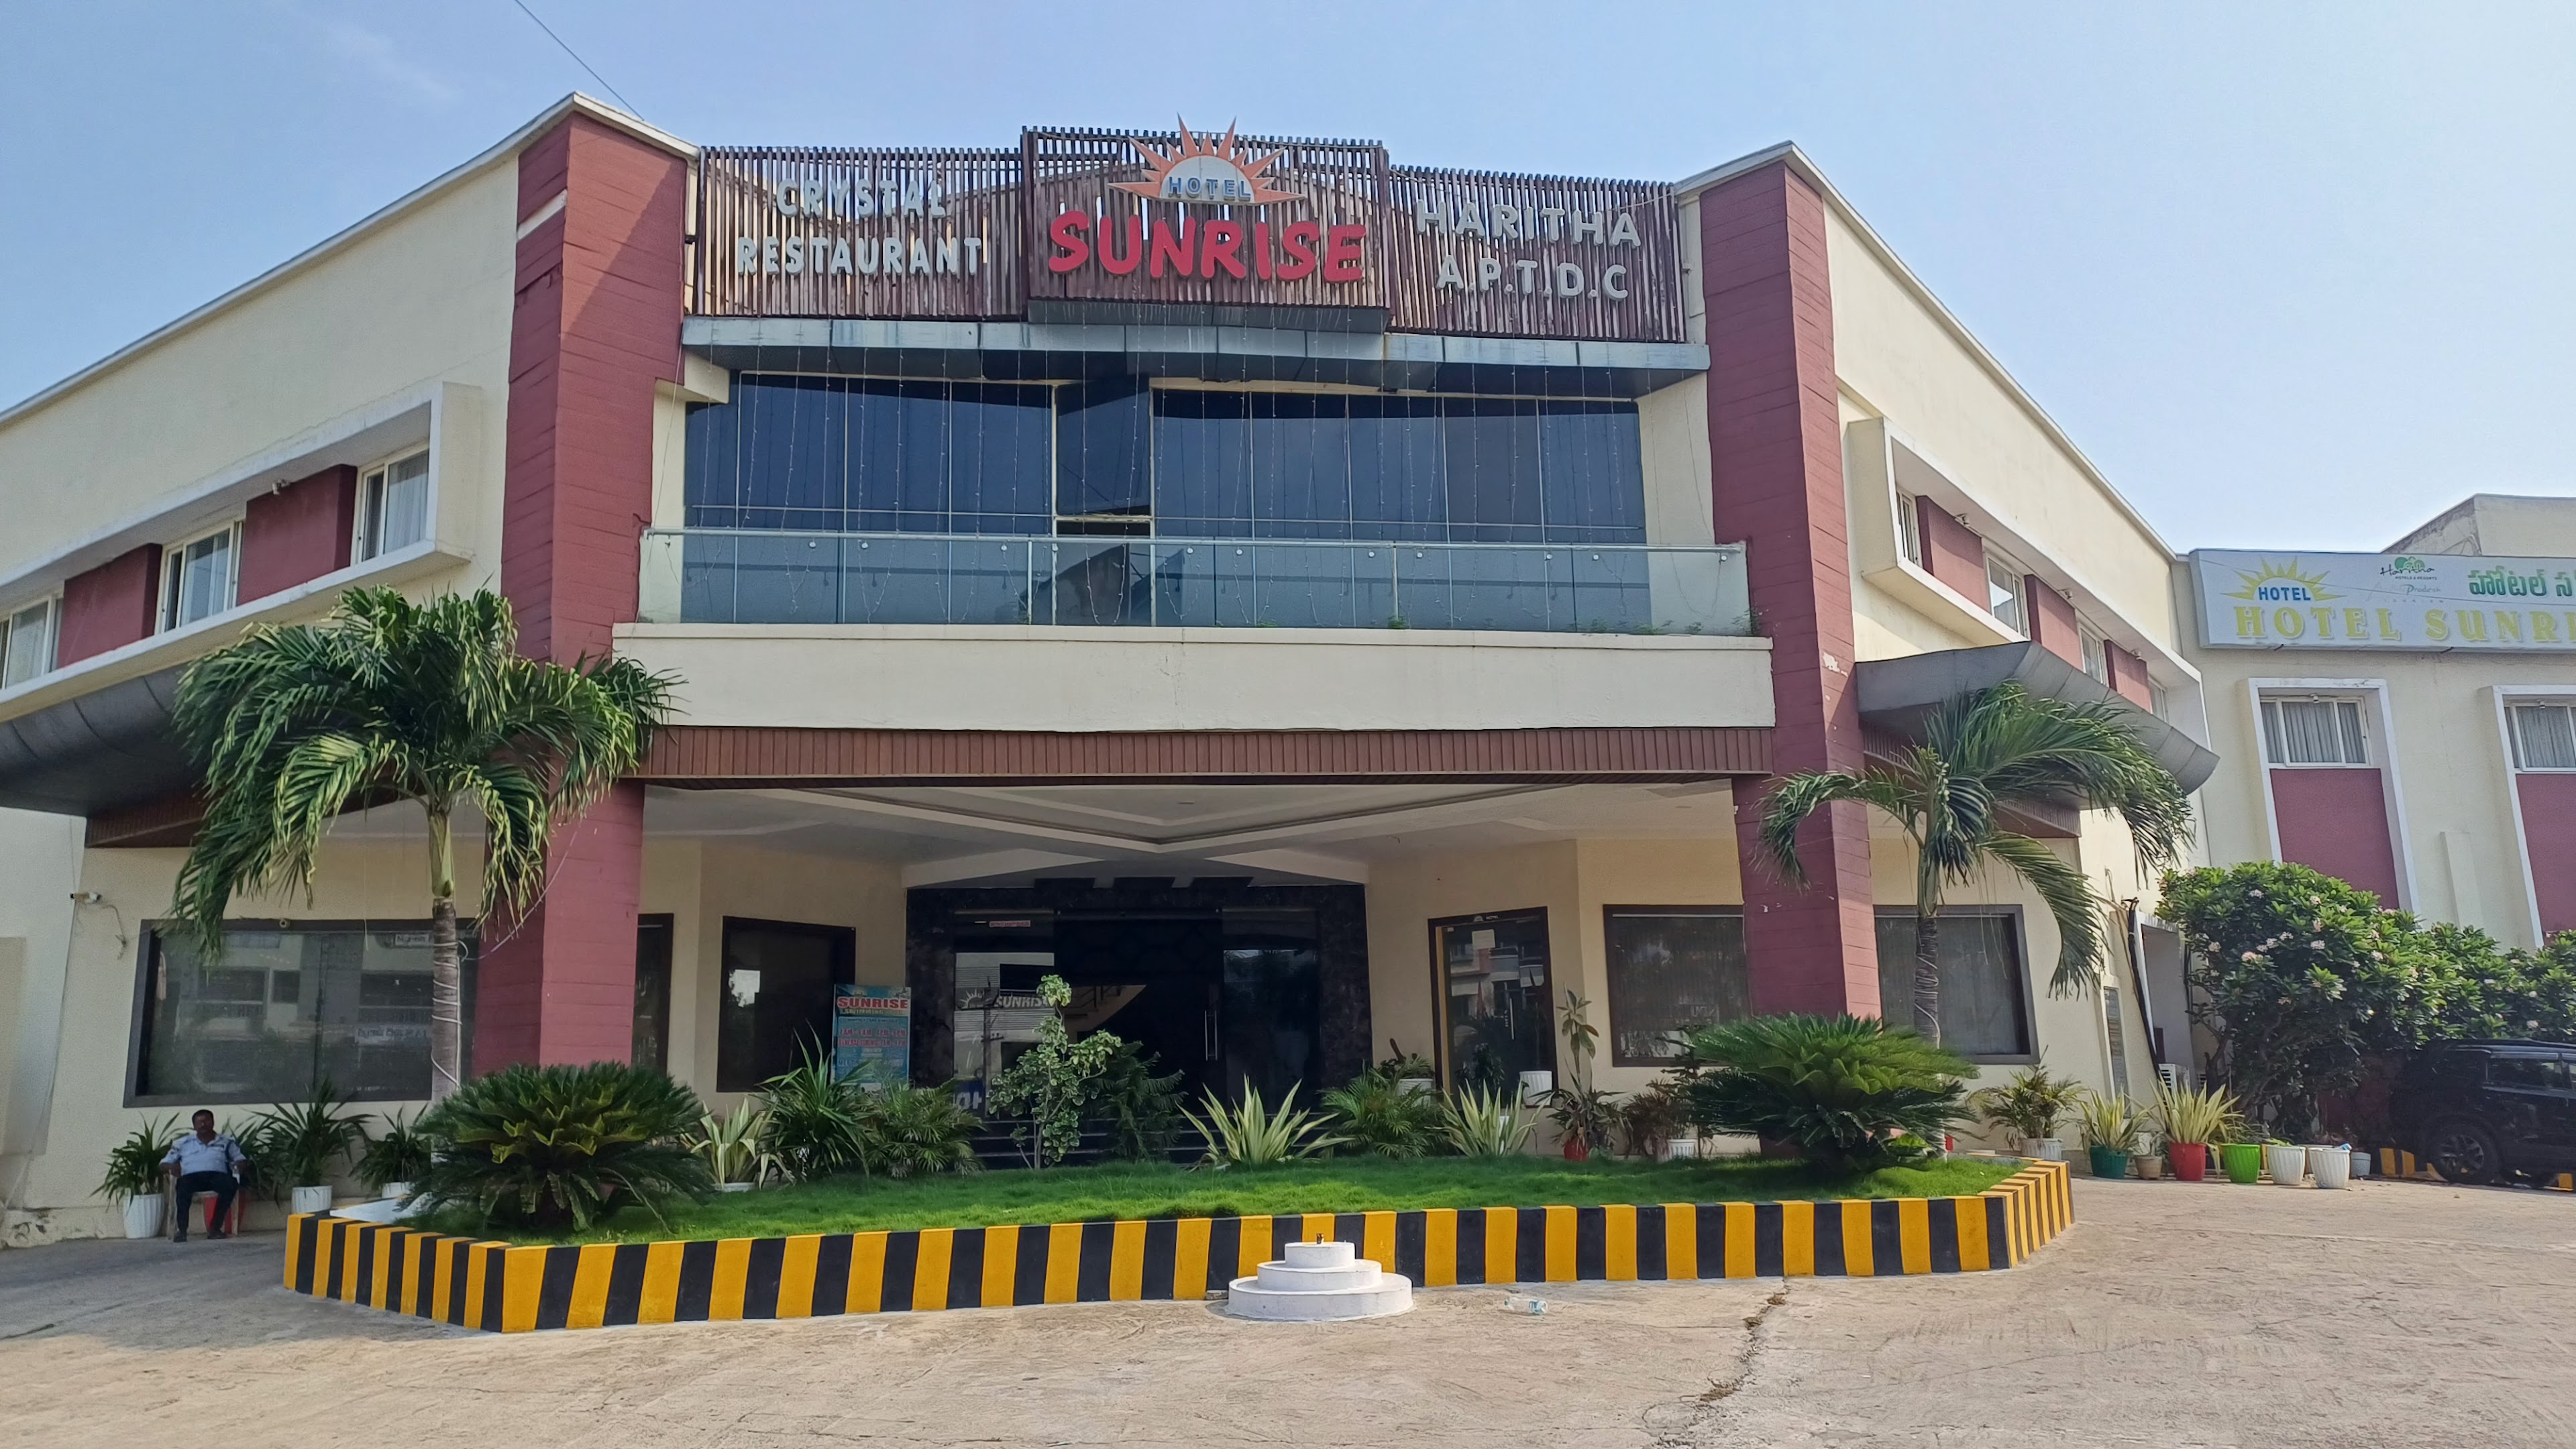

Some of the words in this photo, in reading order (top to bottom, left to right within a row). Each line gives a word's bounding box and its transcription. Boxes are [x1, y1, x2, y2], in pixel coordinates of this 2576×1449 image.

[776, 178, 946, 218] CRYSTAL
[1168, 176, 1252, 199] HOTEL
[1415, 199, 1641, 249] HARITHA
[738, 236, 981, 276] RESTAURANT
[1049, 210, 1366, 283] SUNRISE
[2380, 564, 2435, 576] Haritha
[2467, 566, 2547, 596] హోటల్
[2258, 587, 2311, 601] HOTEL
[2233, 606, 2402, 641] HOTEL
[838, 998, 908, 1009] SUNRISE
